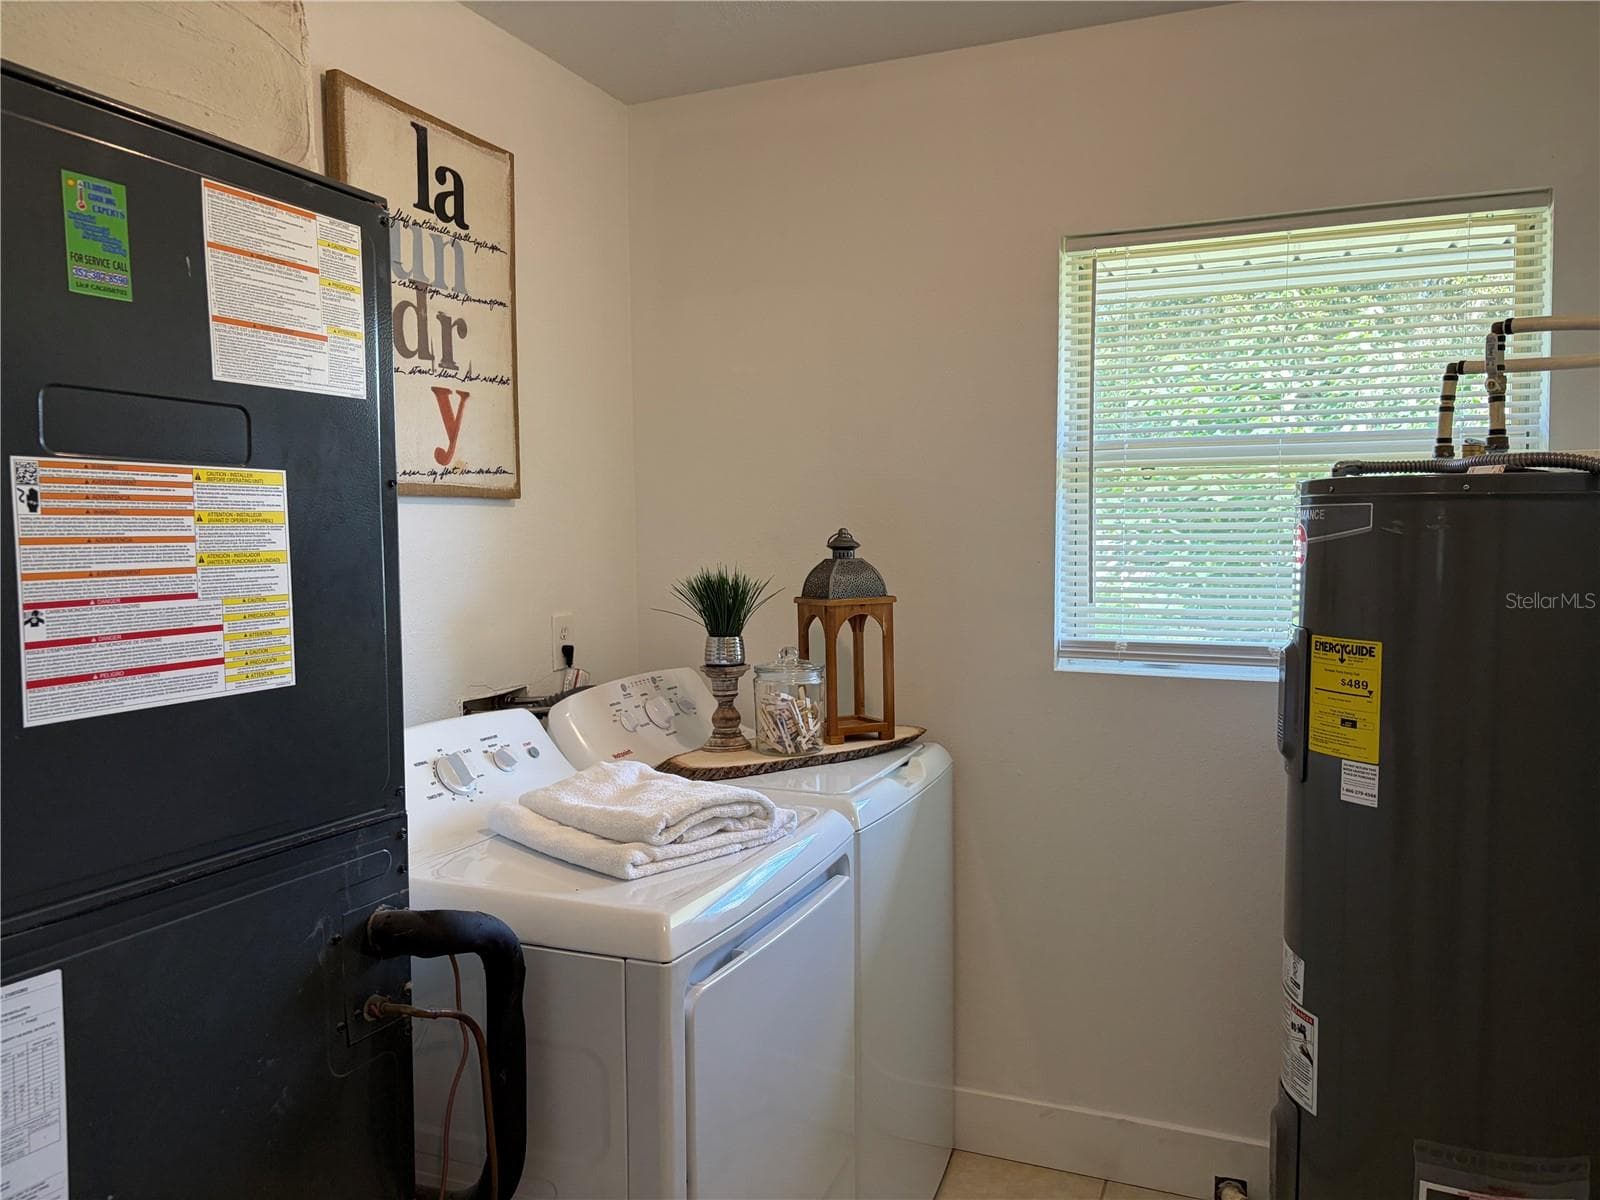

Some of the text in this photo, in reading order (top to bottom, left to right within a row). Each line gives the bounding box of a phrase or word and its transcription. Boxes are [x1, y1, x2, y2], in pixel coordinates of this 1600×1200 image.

[410, 121, 469, 230] la
[70, 252, 128, 272] FOR SERVICE CALL
[392, 281, 467, 371] dr
[431, 386, 470, 466] y
[1314, 640, 1376, 658] ENERGYGUIDE
[250, 671, 274, 679] ATTENTION
[1340, 678, 1369, 690] $489
